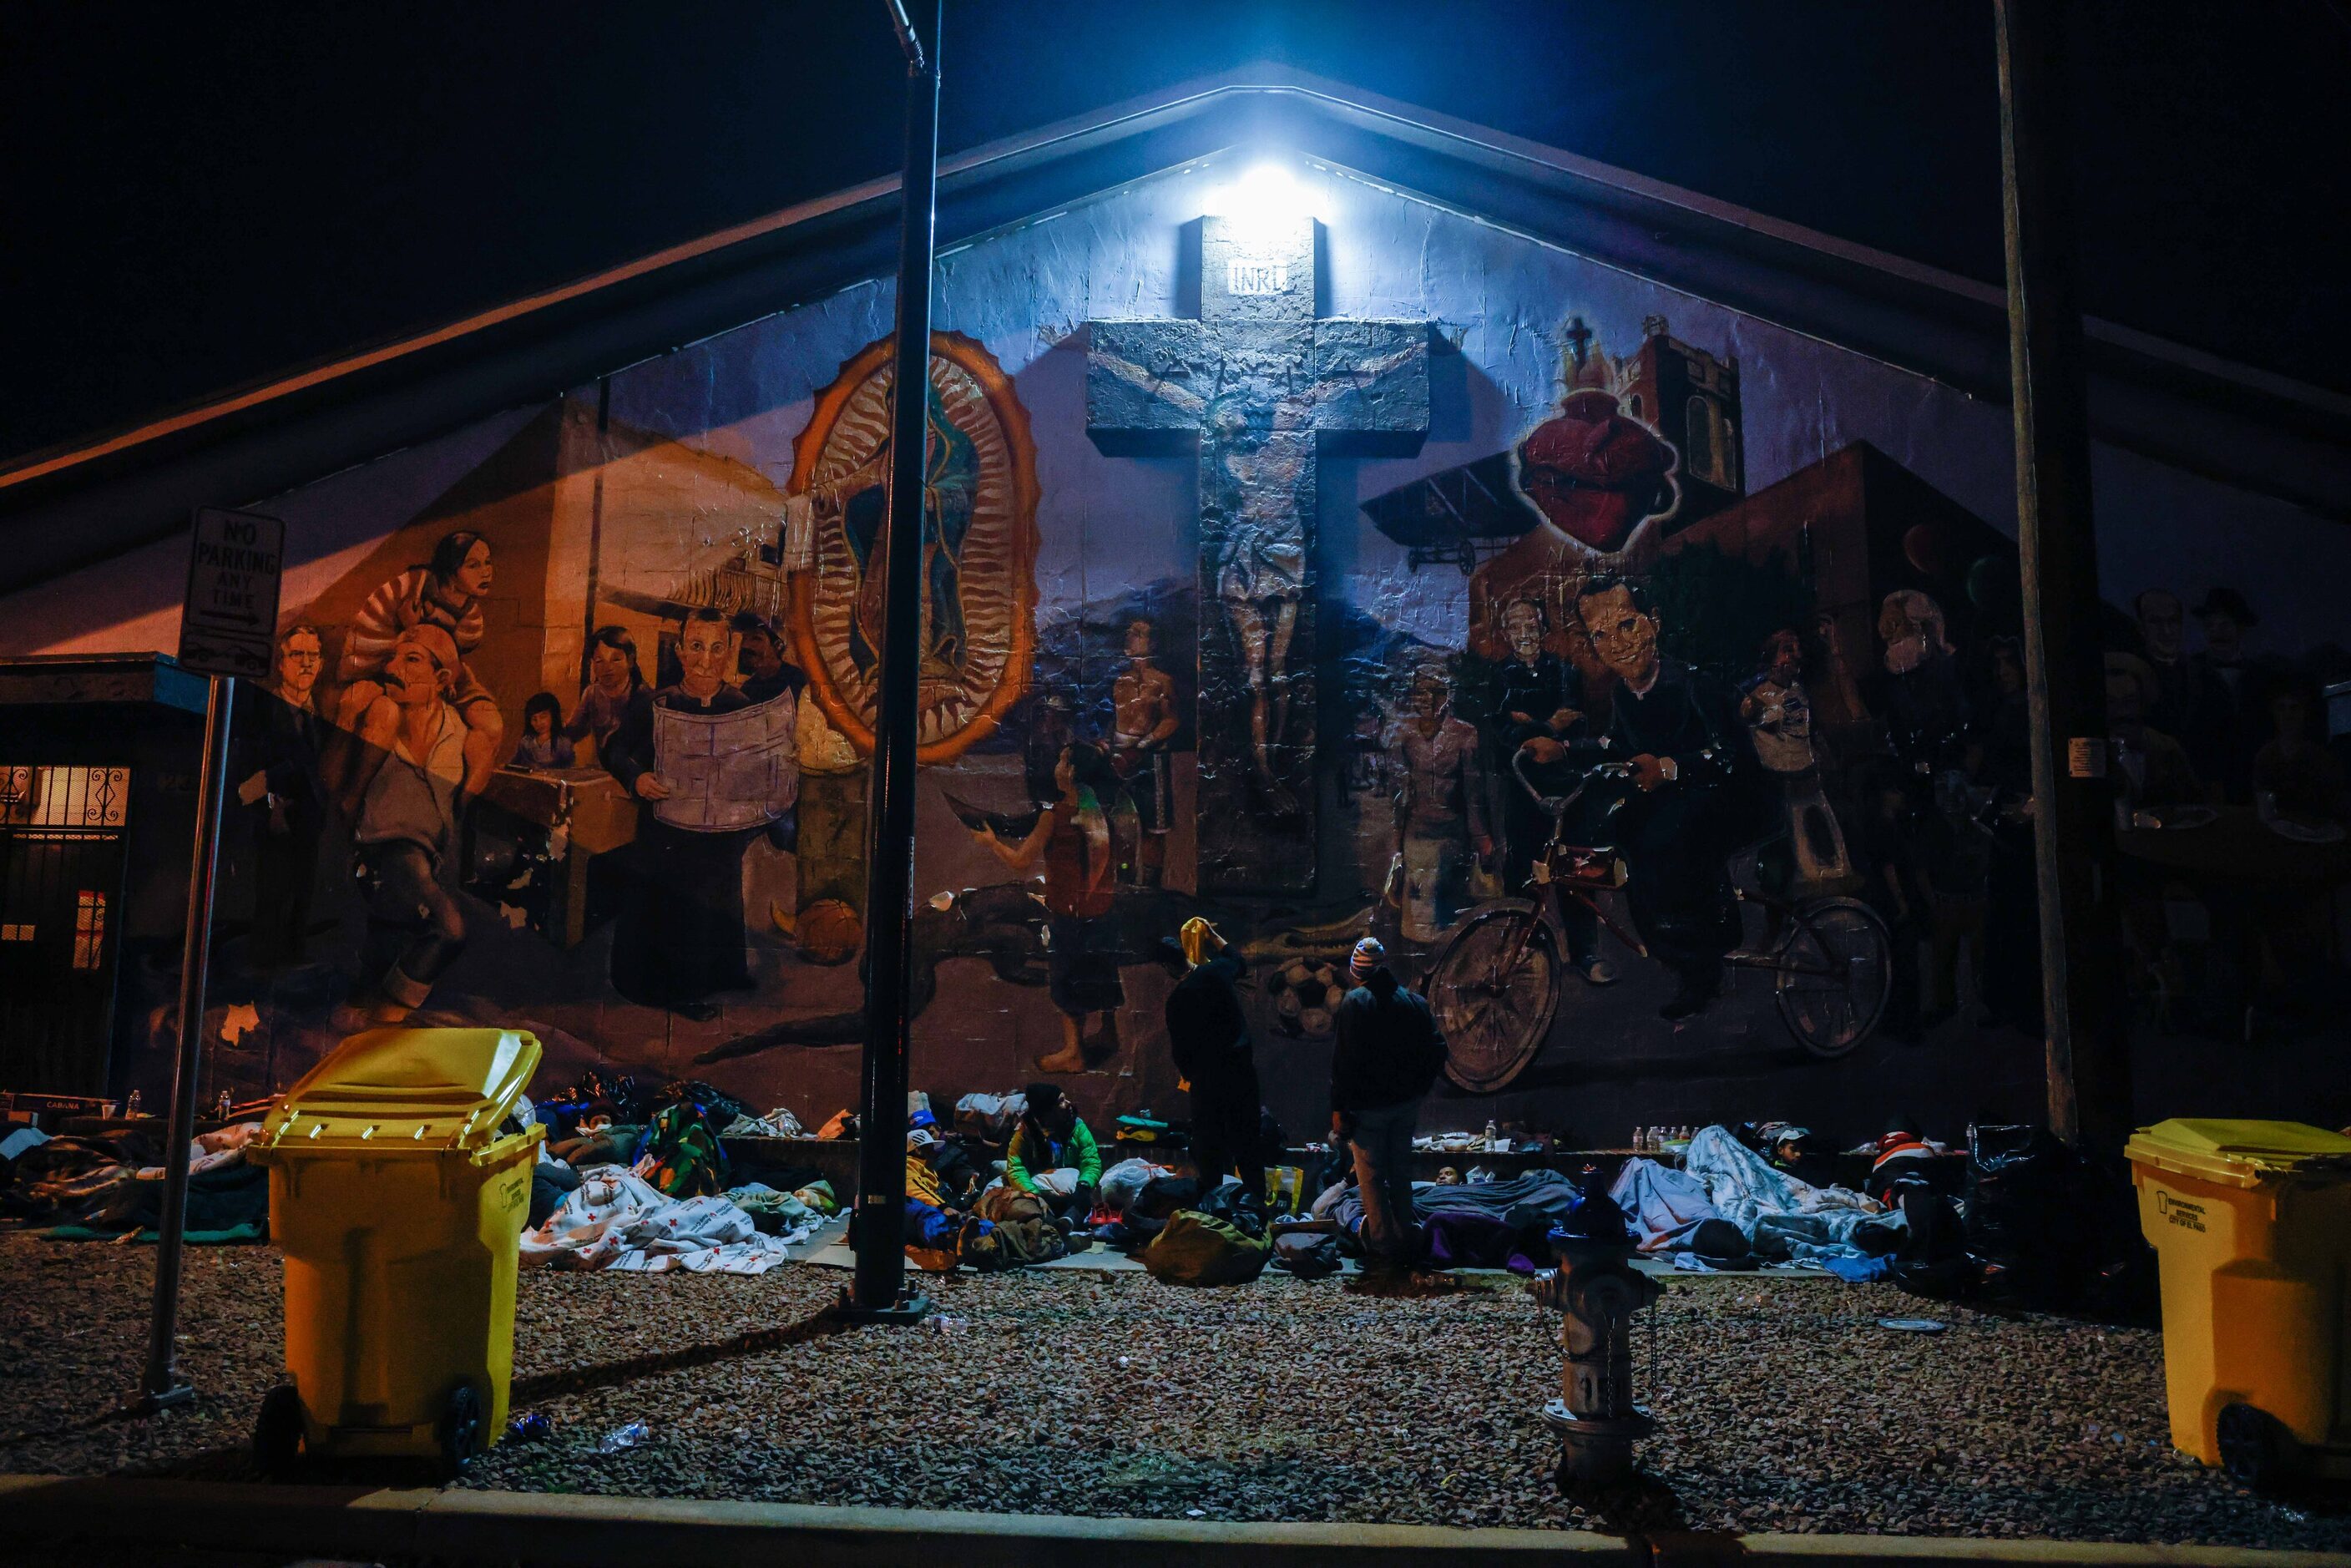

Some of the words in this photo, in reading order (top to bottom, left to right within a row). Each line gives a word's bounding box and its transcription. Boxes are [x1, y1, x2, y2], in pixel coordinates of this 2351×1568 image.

[223, 519, 257, 545] NO
[198, 542, 276, 574] PARKING
[218, 571, 252, 589] ANY
[212, 588, 255, 609] TIME
